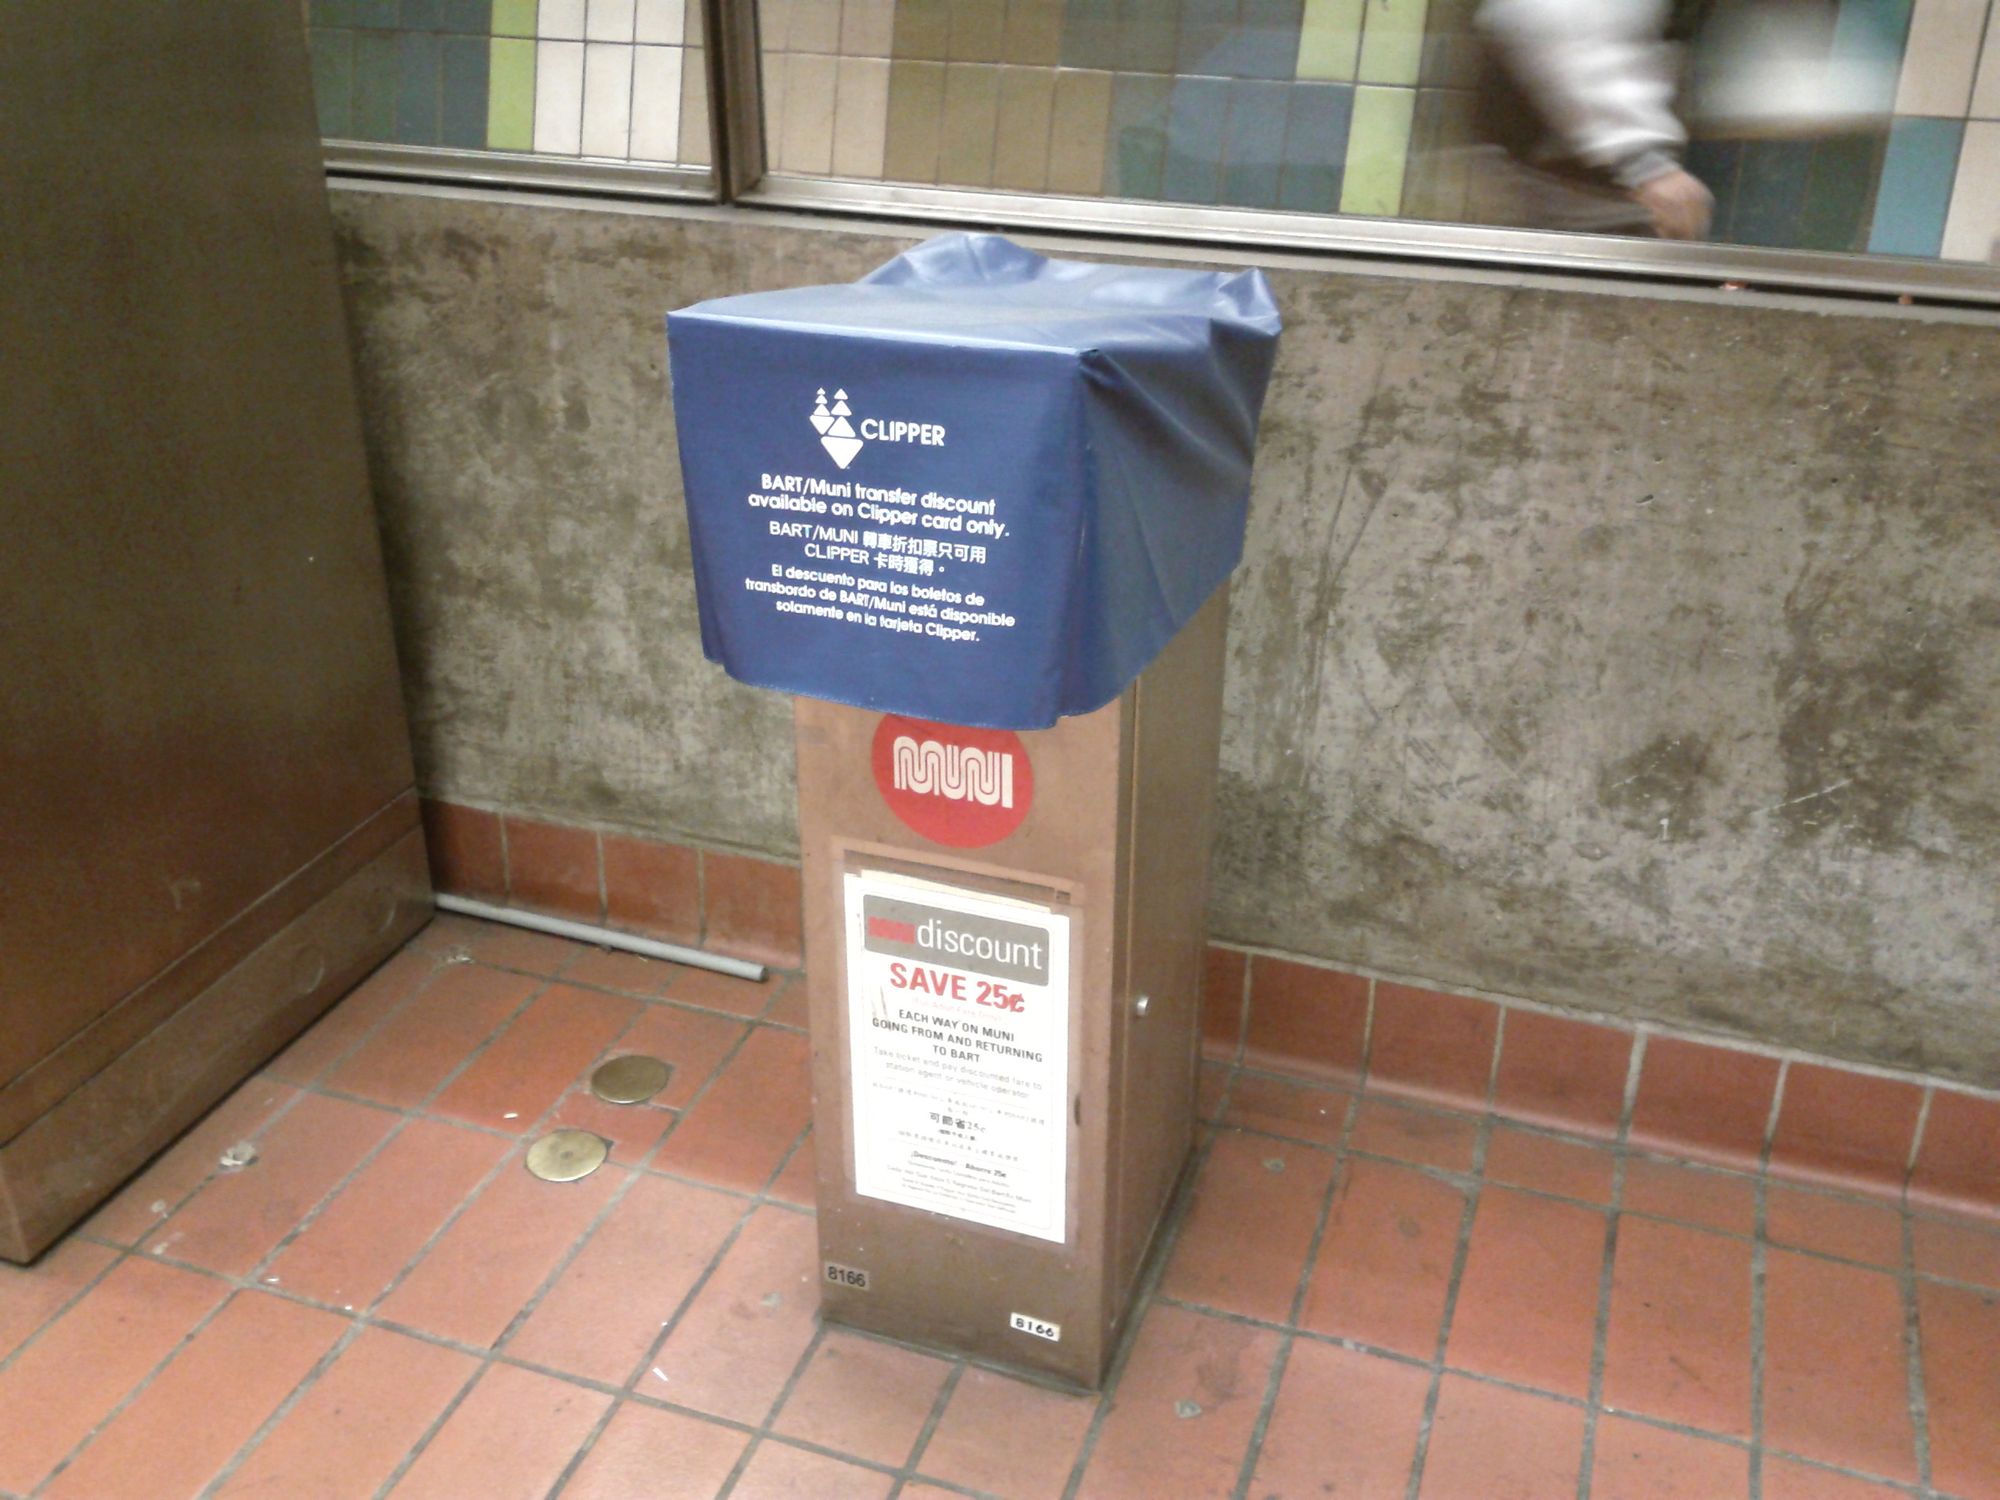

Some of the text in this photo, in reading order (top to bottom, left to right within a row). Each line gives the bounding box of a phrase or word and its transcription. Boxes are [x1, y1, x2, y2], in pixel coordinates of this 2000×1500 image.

[860, 418, 946, 447] CLIPPER
[761, 473, 996, 516] BART/Muni transfer discount
[748, 491, 1010, 539] available on Clipper card only.
[769, 520, 858, 545] BART/MUNI
[804, 543, 869, 565] CLIPPER
[745, 577, 1016, 628] transbordo de BART/Muni está disponible
[771, 563, 985, 606] El descuento para los boletos de
[775, 600, 980, 644] solamente en la tarjeta Clipper.
[916, 918, 1043, 970] discount
[889, 962, 967, 1001] SAVE
[872, 1017, 1043, 1063] GOING FROM AND RETURNING
[899, 1009, 1015, 1042] EACH WAY ON MUNI
[933, 1044, 980, 1063] TO BART
[827, 1265, 866, 1288] 8166
[1016, 1317, 1054, 1338] 8166
